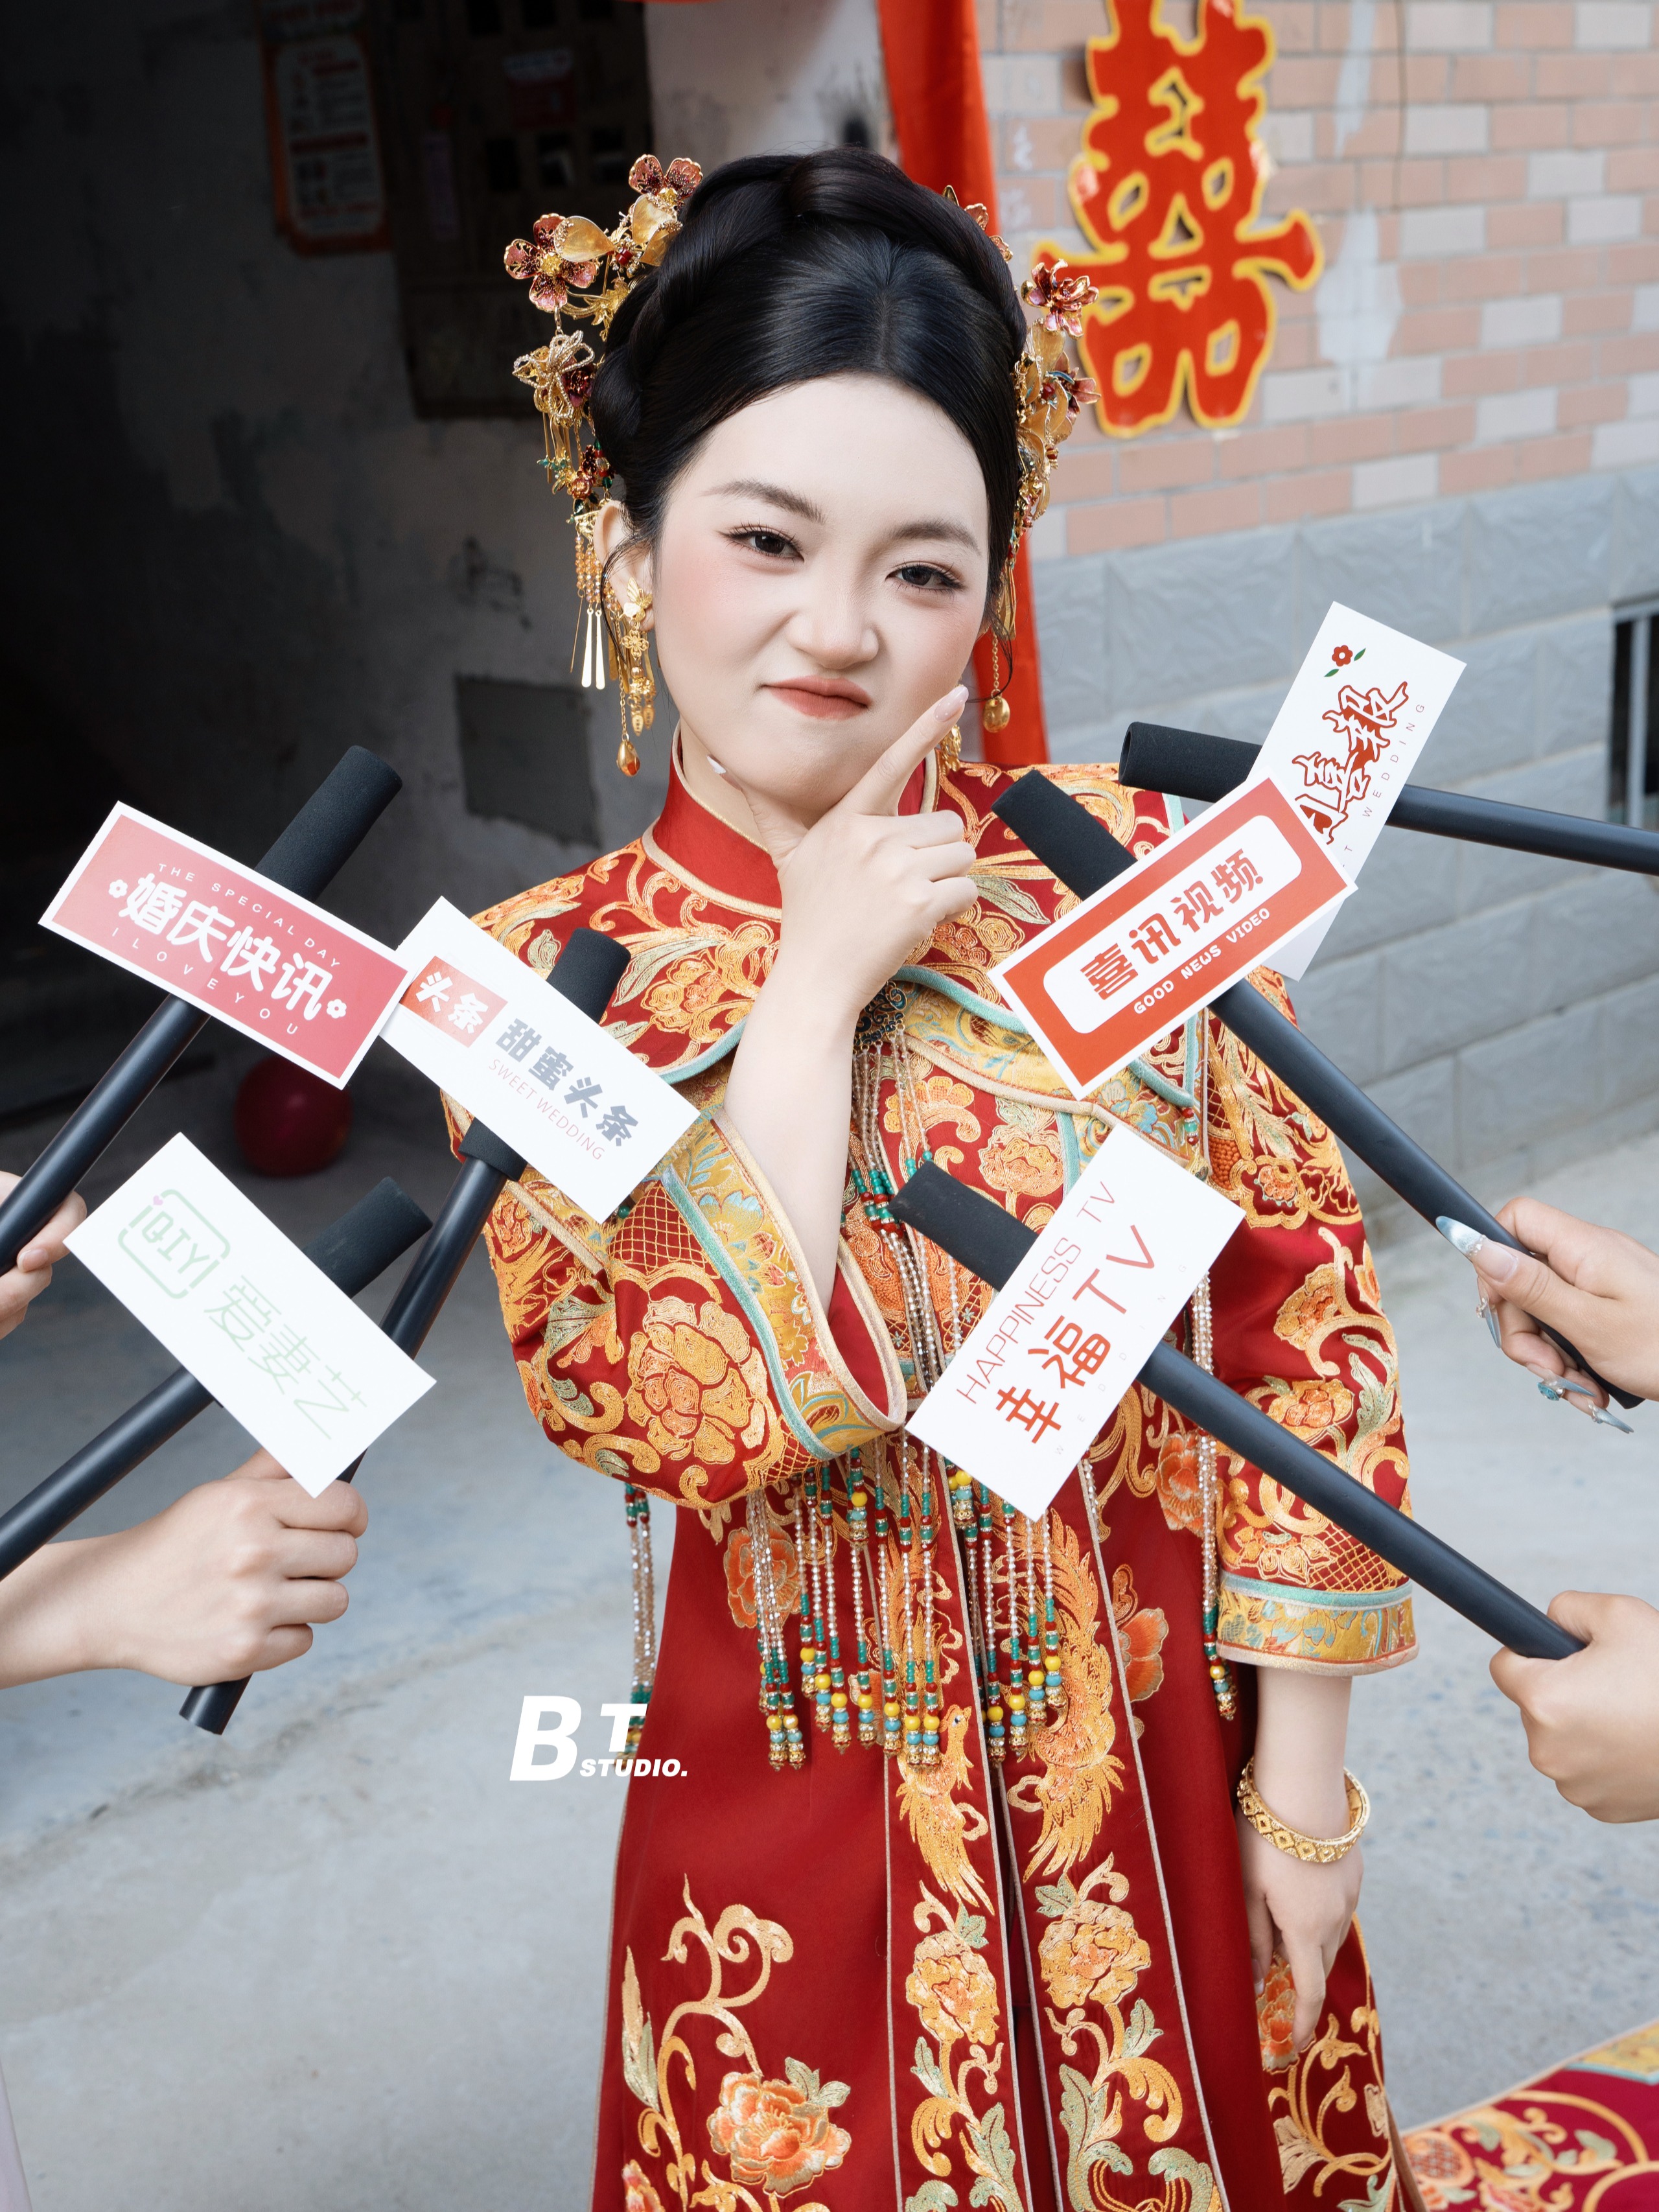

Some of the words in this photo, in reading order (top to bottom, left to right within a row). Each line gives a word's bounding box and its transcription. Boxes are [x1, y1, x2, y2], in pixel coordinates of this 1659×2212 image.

[1362, 703, 1426, 818] WEDDING
[118, 872, 333, 1021] 婚庆快讯
[158, 863, 196, 882] THE
[211, 882, 295, 936] SPECIAL
[304, 937, 341, 968] DAY
[1080, 848, 1264, 1001] 喜讯视频
[1133, 980, 1175, 1016] GOOD
[1181, 945, 1222, 980] NEWS
[1225, 907, 1270, 945] VIDEO
[415, 971, 489, 1034] 头条
[489, 1058, 537, 1100] SWEET
[536, 1097, 605, 1160] WEDDING
[495, 1018, 639, 1147] 甜蜜头条
[956, 1237, 1082, 1404] HAPPINESS
[1076, 1181, 1115, 1223] TV
[203, 1275, 368, 1440] 爱妻艺
[1054, 1263, 1187, 1456] WEDDING
